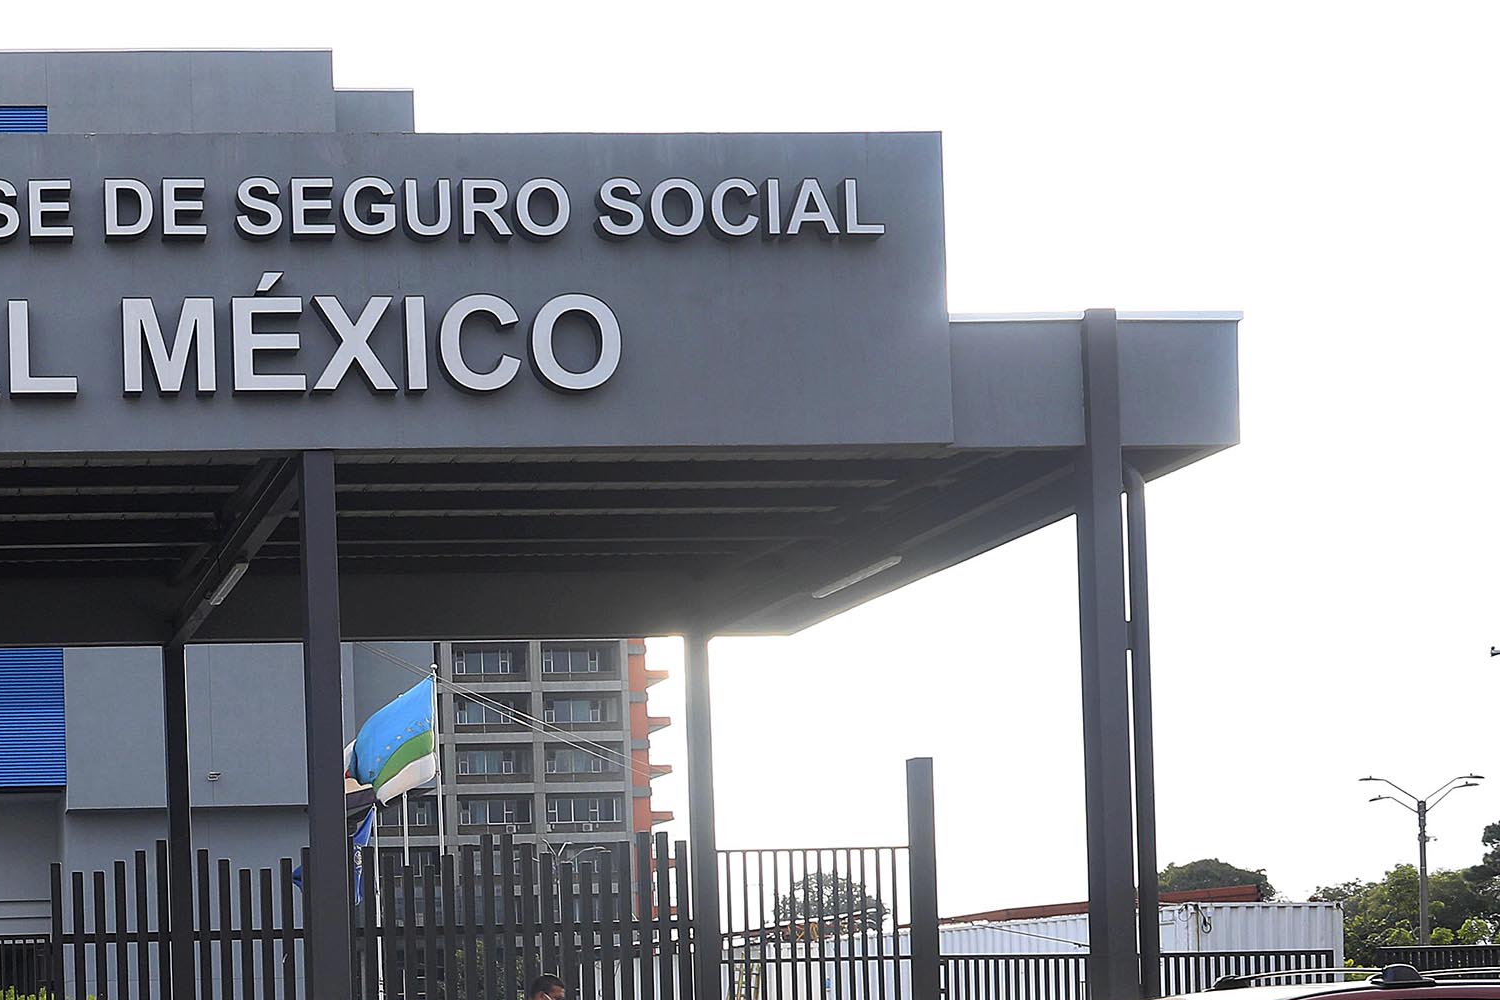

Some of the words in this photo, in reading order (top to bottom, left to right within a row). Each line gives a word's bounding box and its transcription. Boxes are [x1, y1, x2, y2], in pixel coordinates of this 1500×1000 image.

[103, 178, 208, 236] DE
[235, 176, 571, 240] SEGURO
[598, 177, 886, 240] SOCIAL
[121, 271, 623, 396] MÉXICO
